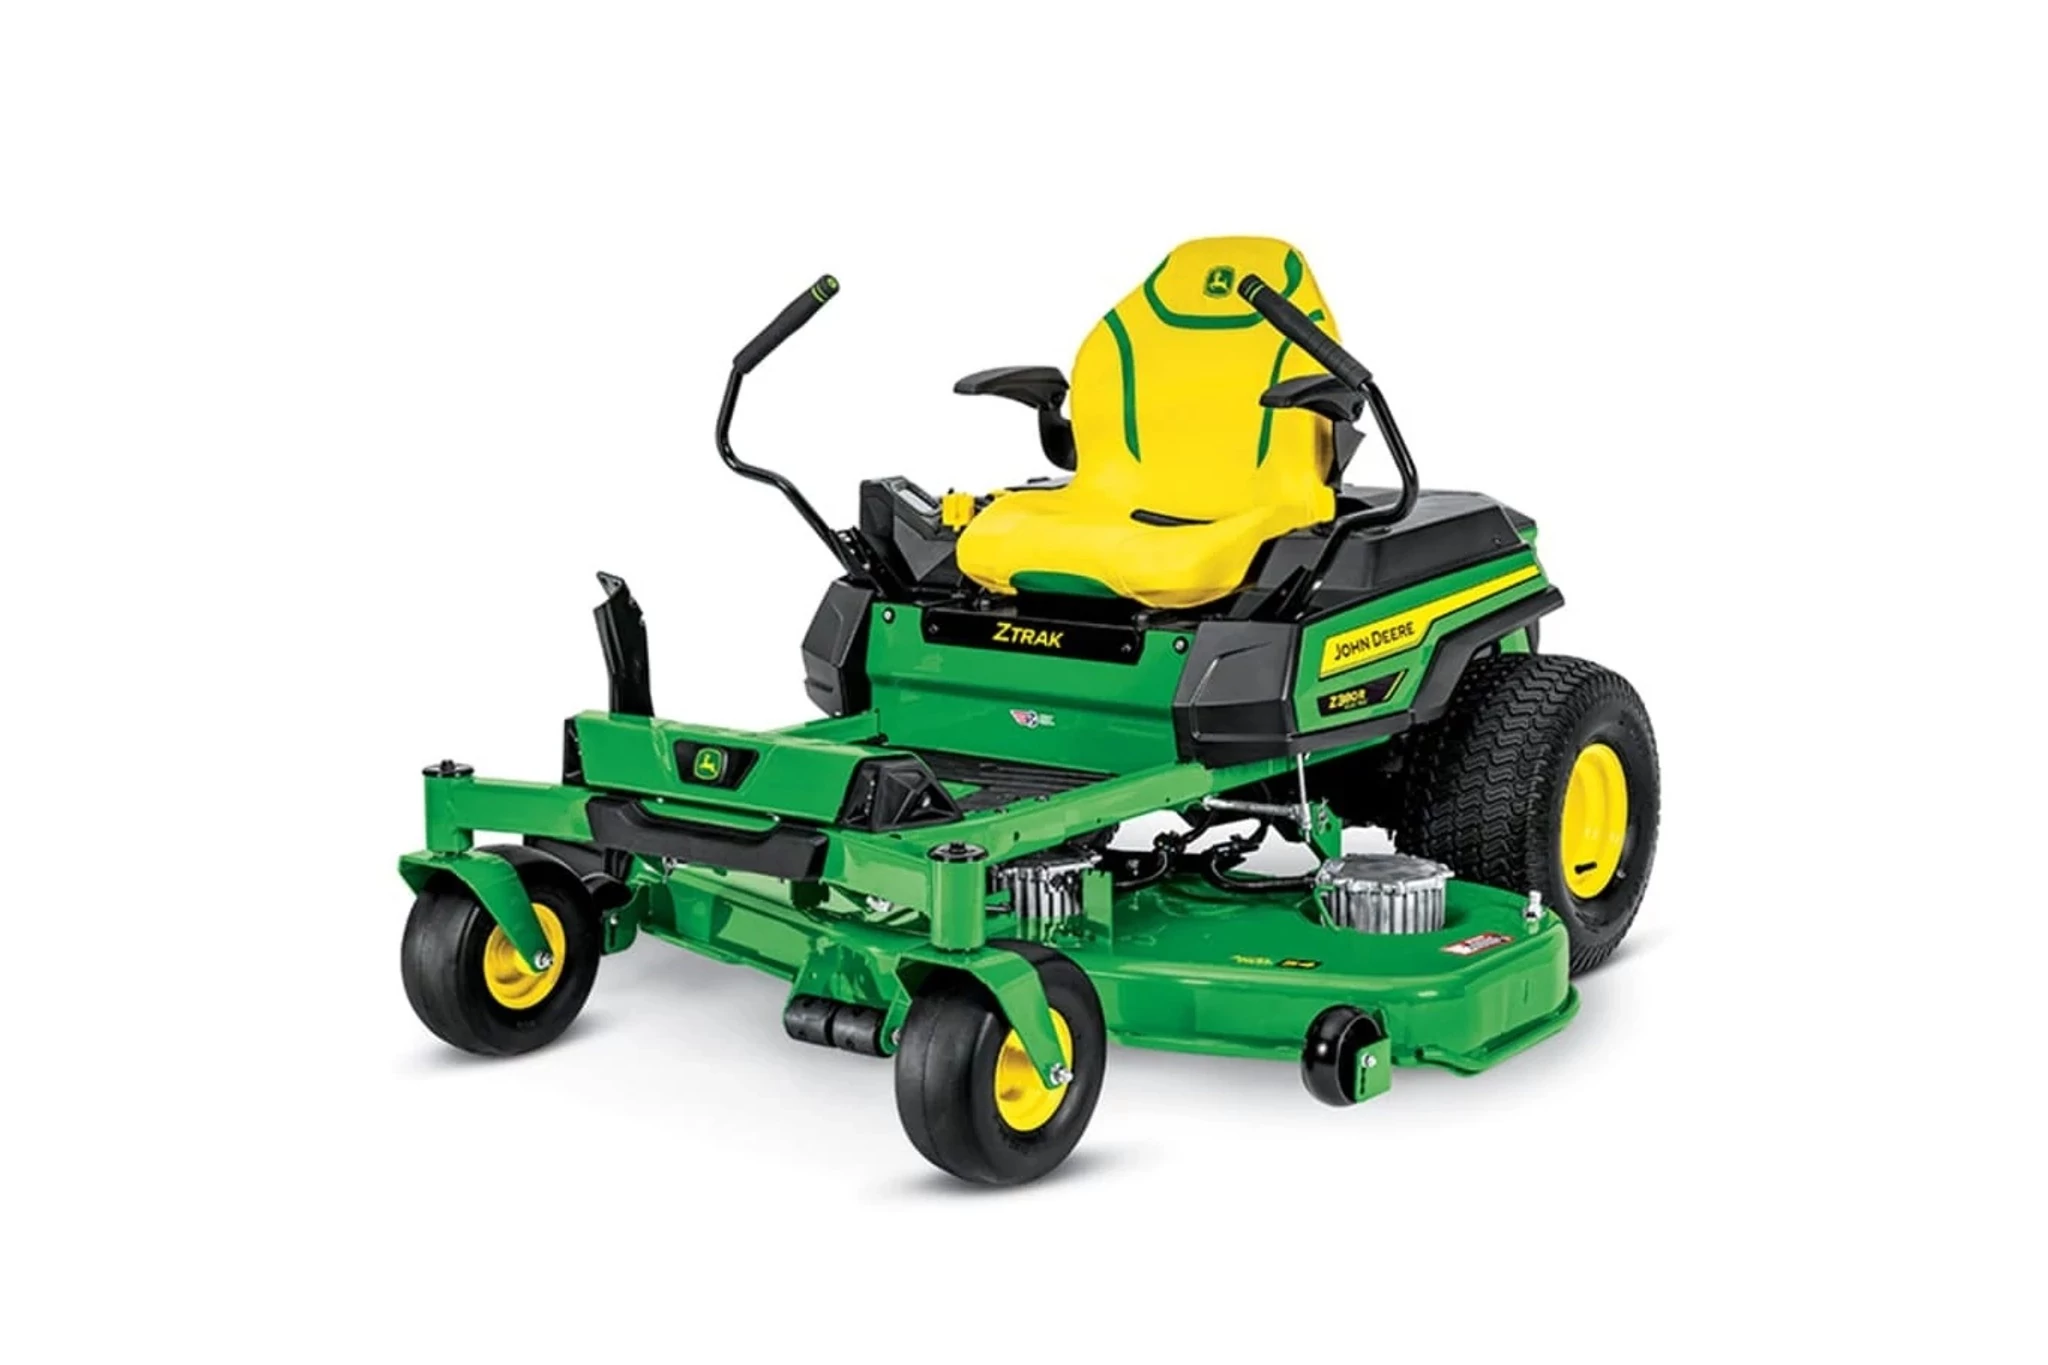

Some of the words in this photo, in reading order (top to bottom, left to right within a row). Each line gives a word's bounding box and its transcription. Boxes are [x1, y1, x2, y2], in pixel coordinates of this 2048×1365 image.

[992, 621, 1064, 649] ZTRAK
[1334, 636, 1370, 661] JOHN
[1371, 622, 1414, 647] DEERE
